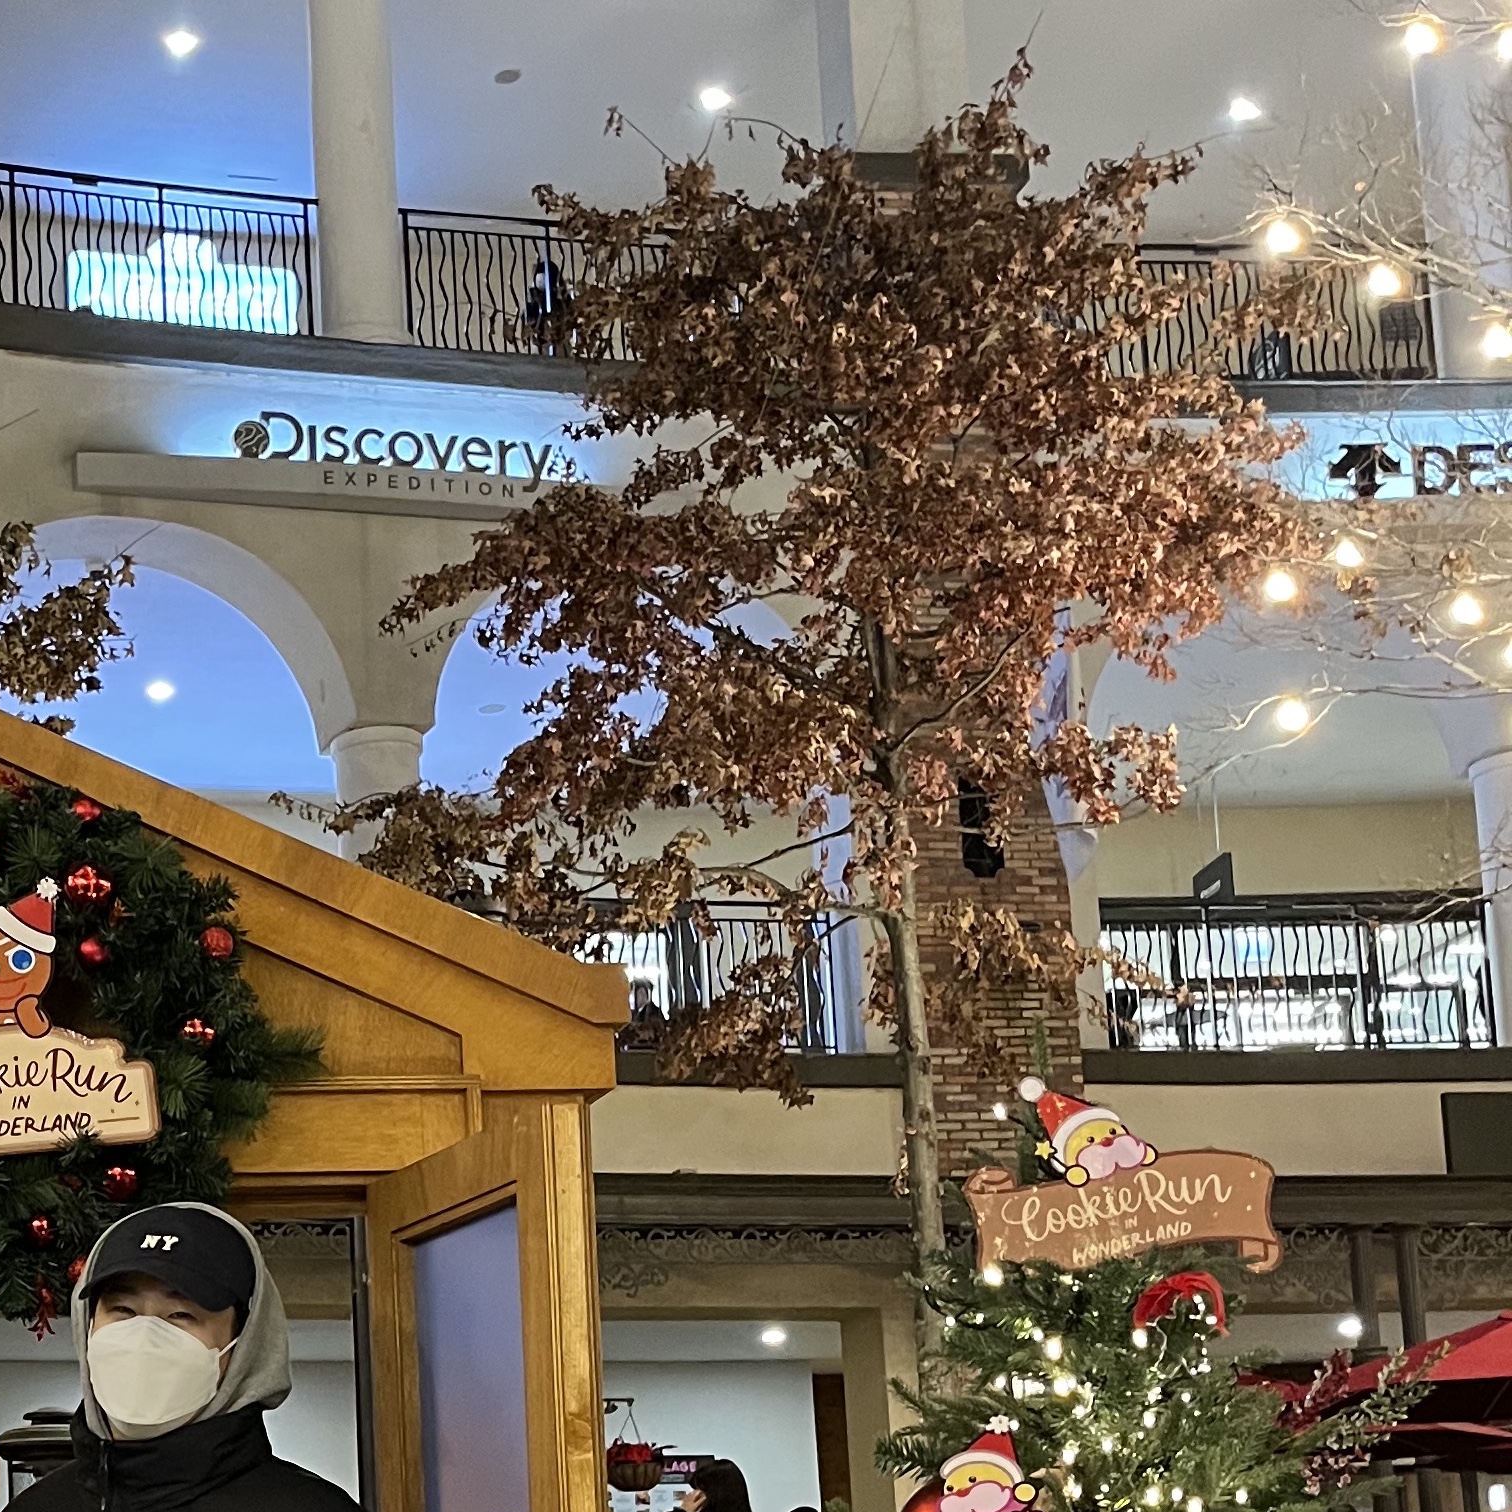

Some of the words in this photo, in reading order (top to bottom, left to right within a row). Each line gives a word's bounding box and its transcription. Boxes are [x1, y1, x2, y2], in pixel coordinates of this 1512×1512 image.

[259, 410, 553, 493] Discovery
[323, 469, 516, 499] EXPEDITION
[11, 1094, 31, 1111] IN
[1124, 1214, 1139, 1229] IN
[140, 1234, 179, 1251] NY
[1072, 1220, 1193, 1266] WONDERLAND
